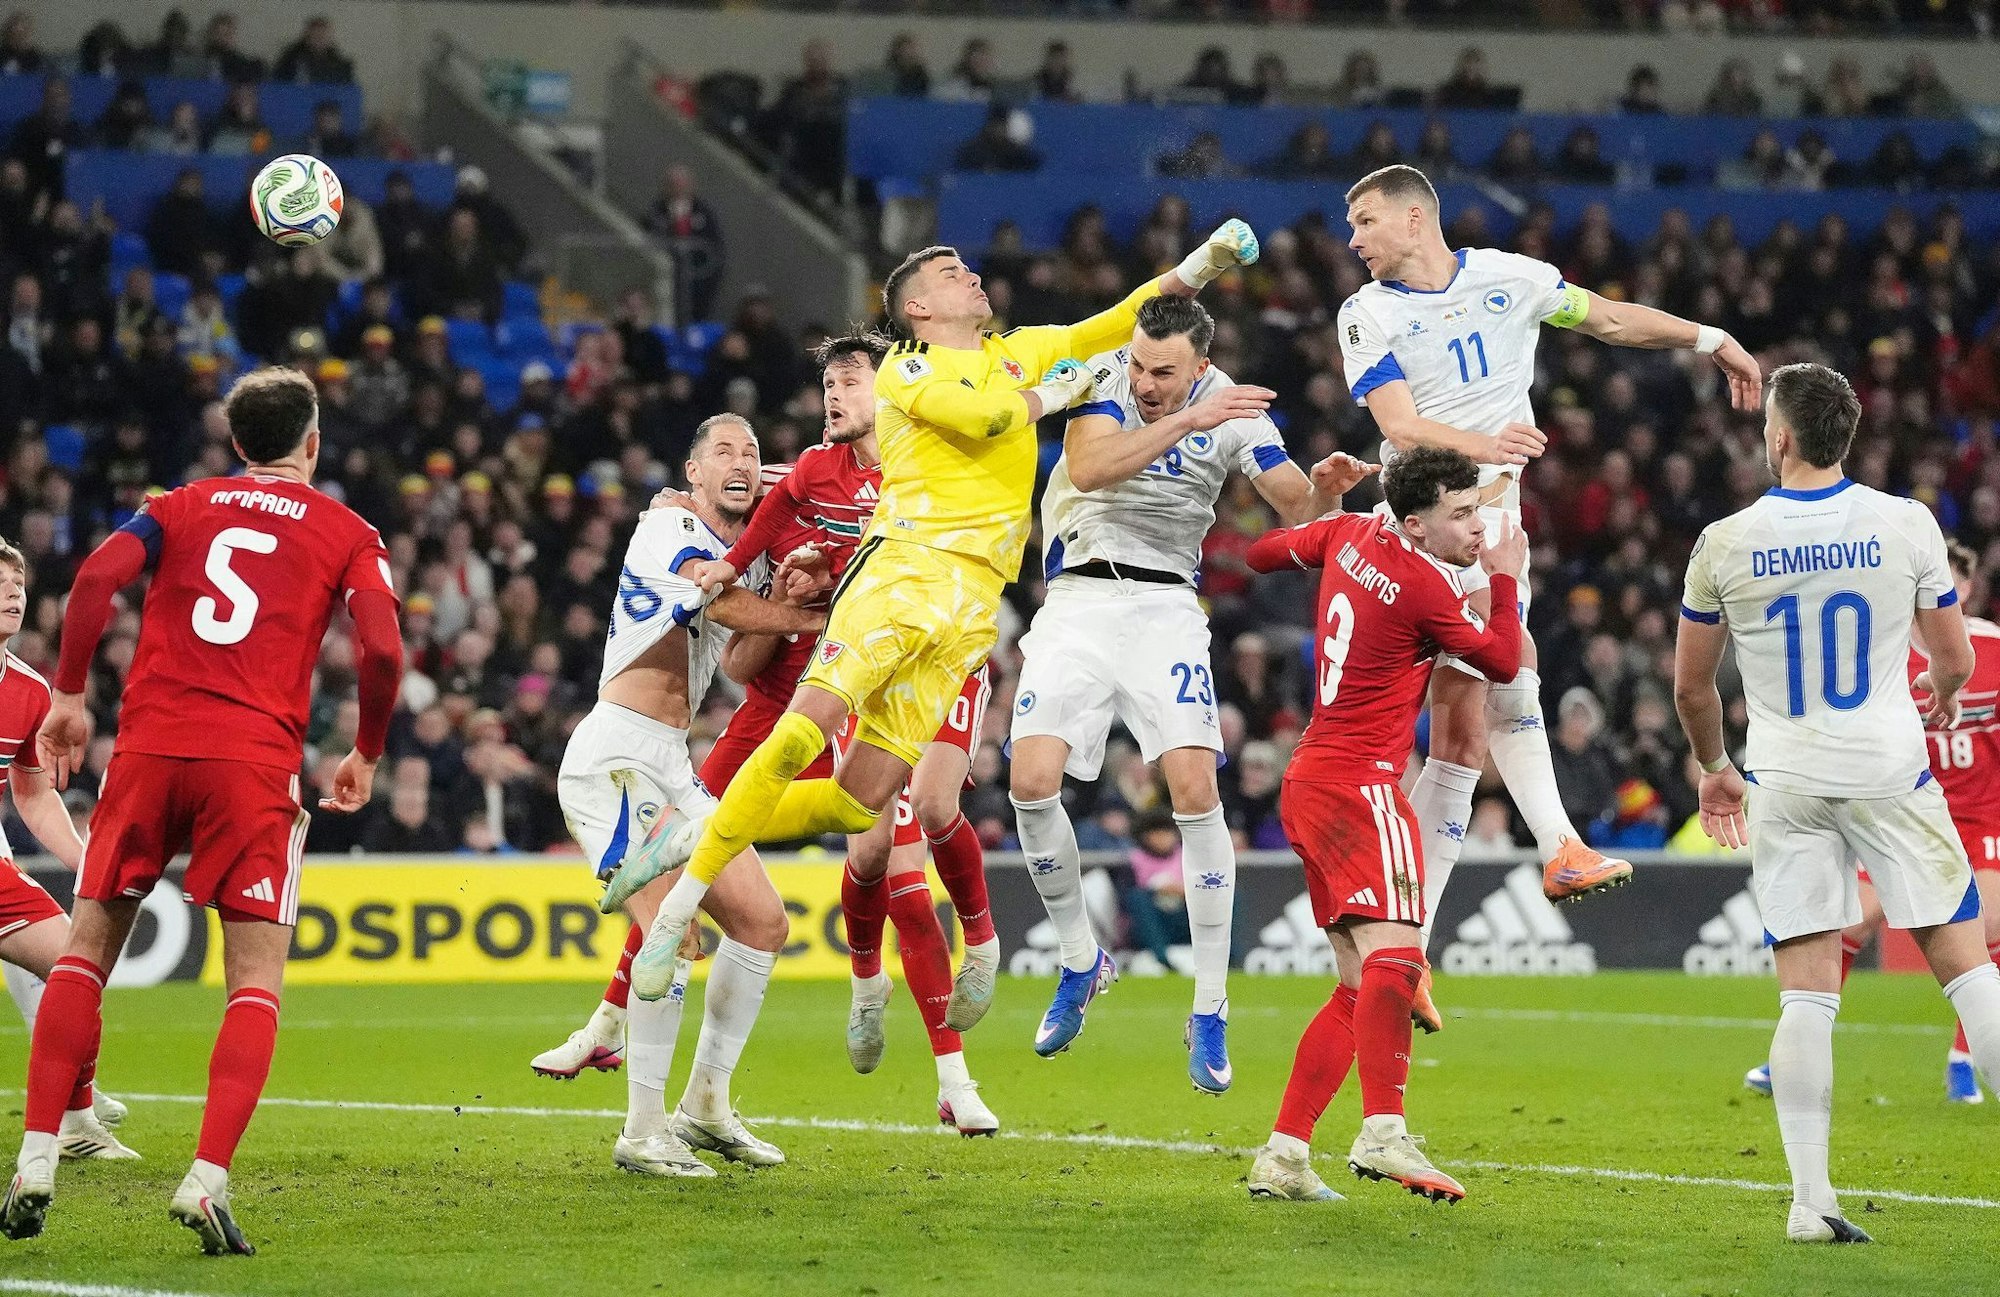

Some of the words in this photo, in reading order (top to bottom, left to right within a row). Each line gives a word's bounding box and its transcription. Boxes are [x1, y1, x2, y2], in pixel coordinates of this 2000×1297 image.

[1407, 328, 1430, 337] KELME
[1447, 331, 1488, 383] 11
[210, 490, 308, 521] AMPADU
[1752, 535, 1882, 578] DEMIROVIĆ
[191, 526, 279, 645] 5
[1319, 592, 1356, 706] 3
[1764, 590, 1873, 719] 10
[1171, 662, 1213, 706] 23
[1935, 732, 1975, 770] 18
[1032, 865, 1064, 876] KELME
[1194, 882, 1230, 890] KELME
[1441, 942, 1598, 977] adidas
[927, 994, 951, 1004] CYM
